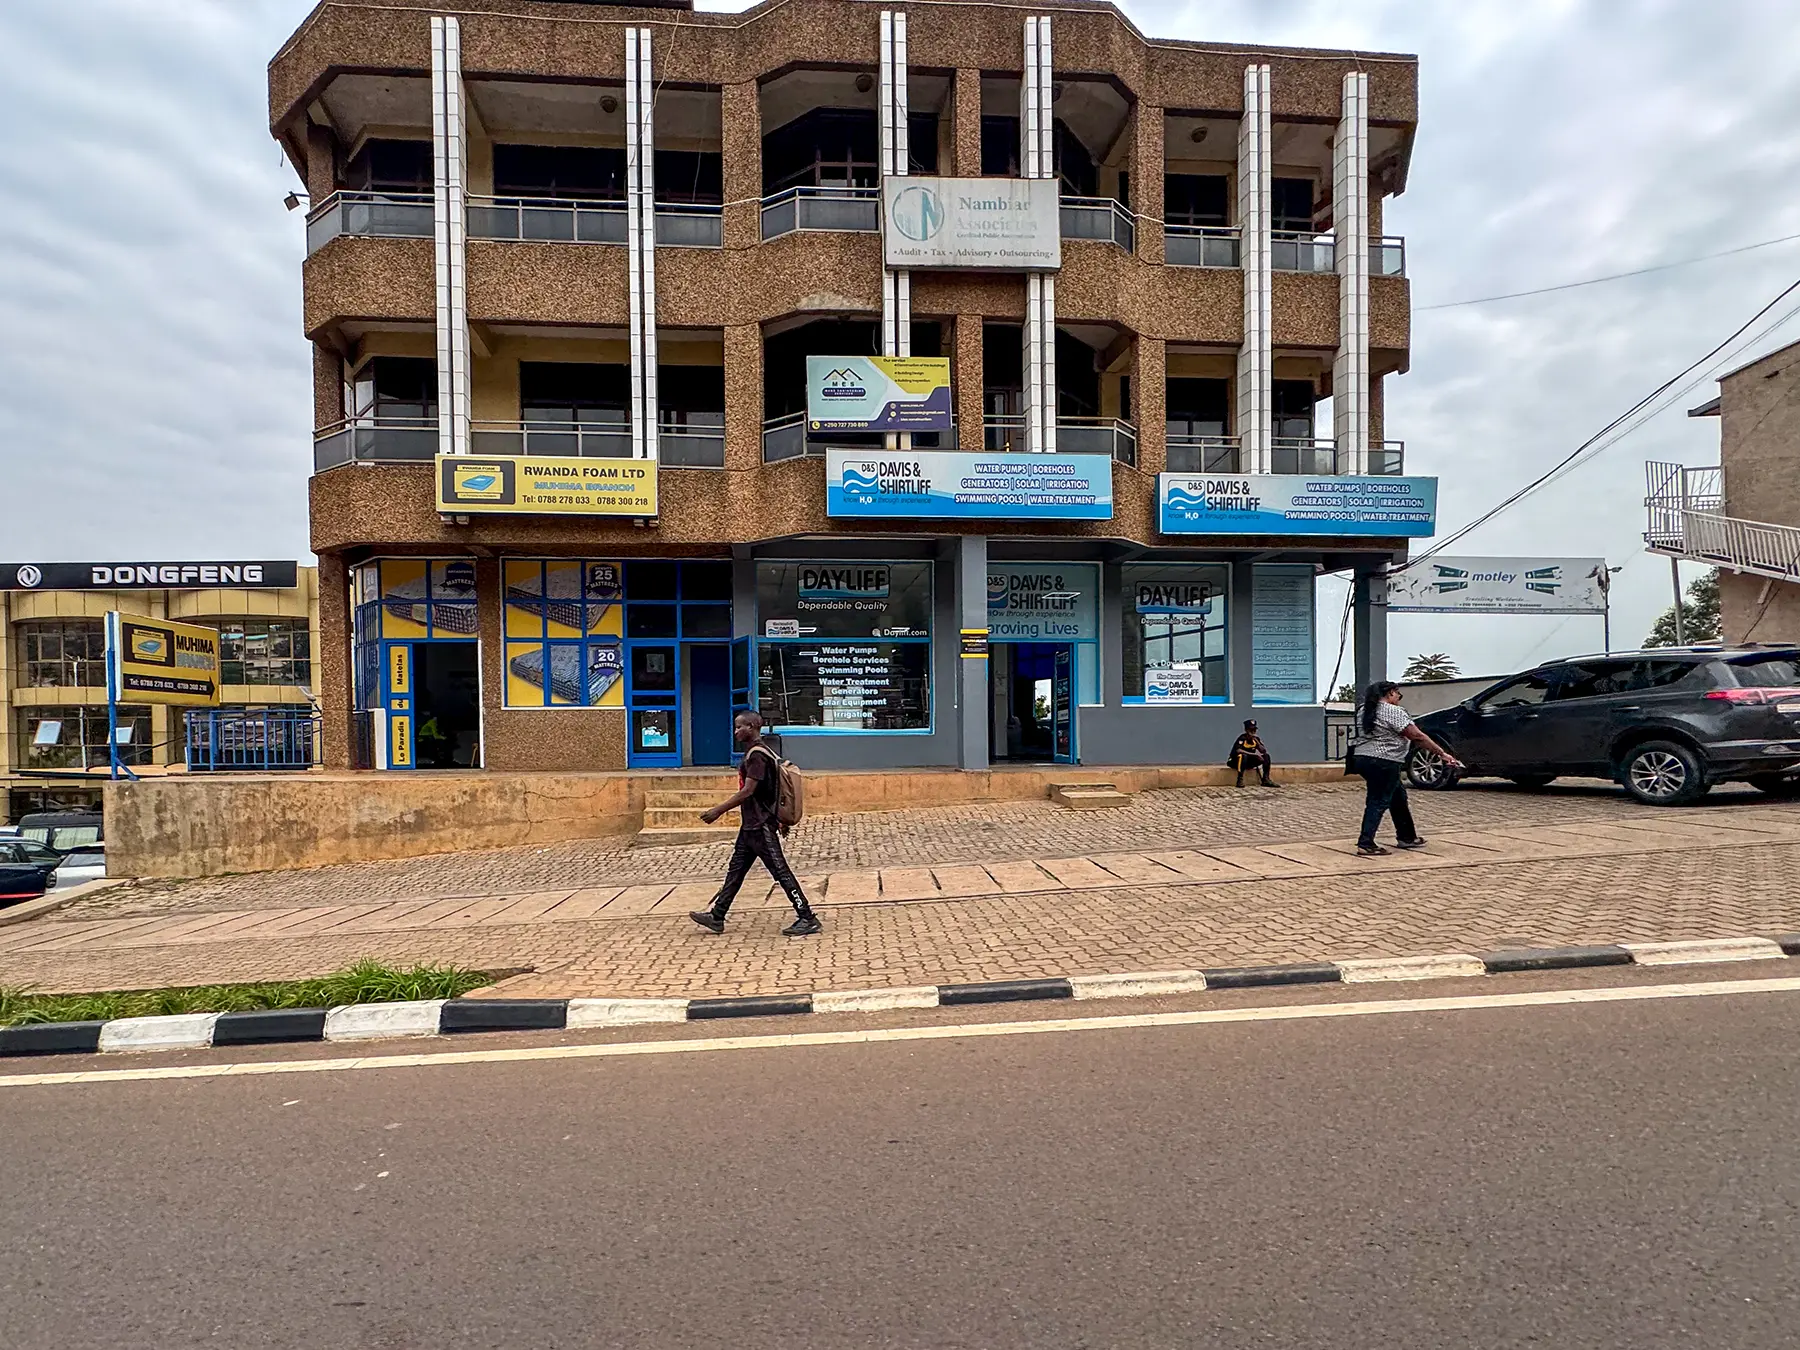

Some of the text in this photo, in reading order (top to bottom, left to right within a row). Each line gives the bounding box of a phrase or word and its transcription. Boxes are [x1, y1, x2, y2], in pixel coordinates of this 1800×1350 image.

[959, 196, 1030, 210] Nambiar
[955, 216, 1037, 231] Associts
[898, 248, 1050, 259] Audit Tax Advisory Outsourcing
[524, 466, 646, 478] RWANDA FOAM LTD
[862, 464, 876, 472] D&S
[880, 462, 921, 477] DAVIS &
[974, 464, 1075, 475] WATER PUMPS BOREHOLES
[534, 482, 583, 490] MUHIMA
[880, 479, 932, 494] SHIRTLIFF
[961, 478, 1090, 490] GENERATORS SOLAR IRRIGATION
[1188, 482, 1203, 490] D&S
[1206, 481, 1250, 494] DAVIS &
[1306, 483, 1410, 494] WATER PUMPS BOREHOLES
[522, 495, 536, 503] Tel:
[538, 496, 557, 504] 0788
[559, 496, 573, 504] 278
[597, 497, 616, 505] 0788
[618, 498, 633, 506] 300
[635, 498, 648, 506] 218
[955, 494, 1096, 505] SWIMMING POOLS WATER TREATMENT
[1206, 497, 1260, 511] SHIRTLIFF
[1292, 496, 1424, 508] GENERATORS SOLAR IRRIGATION
[1285, 511, 1430, 522] SWIMMING POOLS WATER TREATMENT
[92, 565, 263, 584] DONGFENG
[594, 570, 613, 580] 25
[803, 569, 887, 590] DAYLIFF
[1472, 572, 1517, 584] motley
[1010, 574, 1065, 590] DAVIS &
[1139, 586, 1209, 606] DAYLIFF
[798, 601, 888, 612] Dependable Quality
[1006, 610, 1034, 618] through
[1044, 622, 1079, 634] Lives
[1182, 618, 1206, 626] Quality
[176, 635, 214, 654] MUHIMA
[598, 652, 615, 662] 20
[842, 698, 887, 707] Equipment
